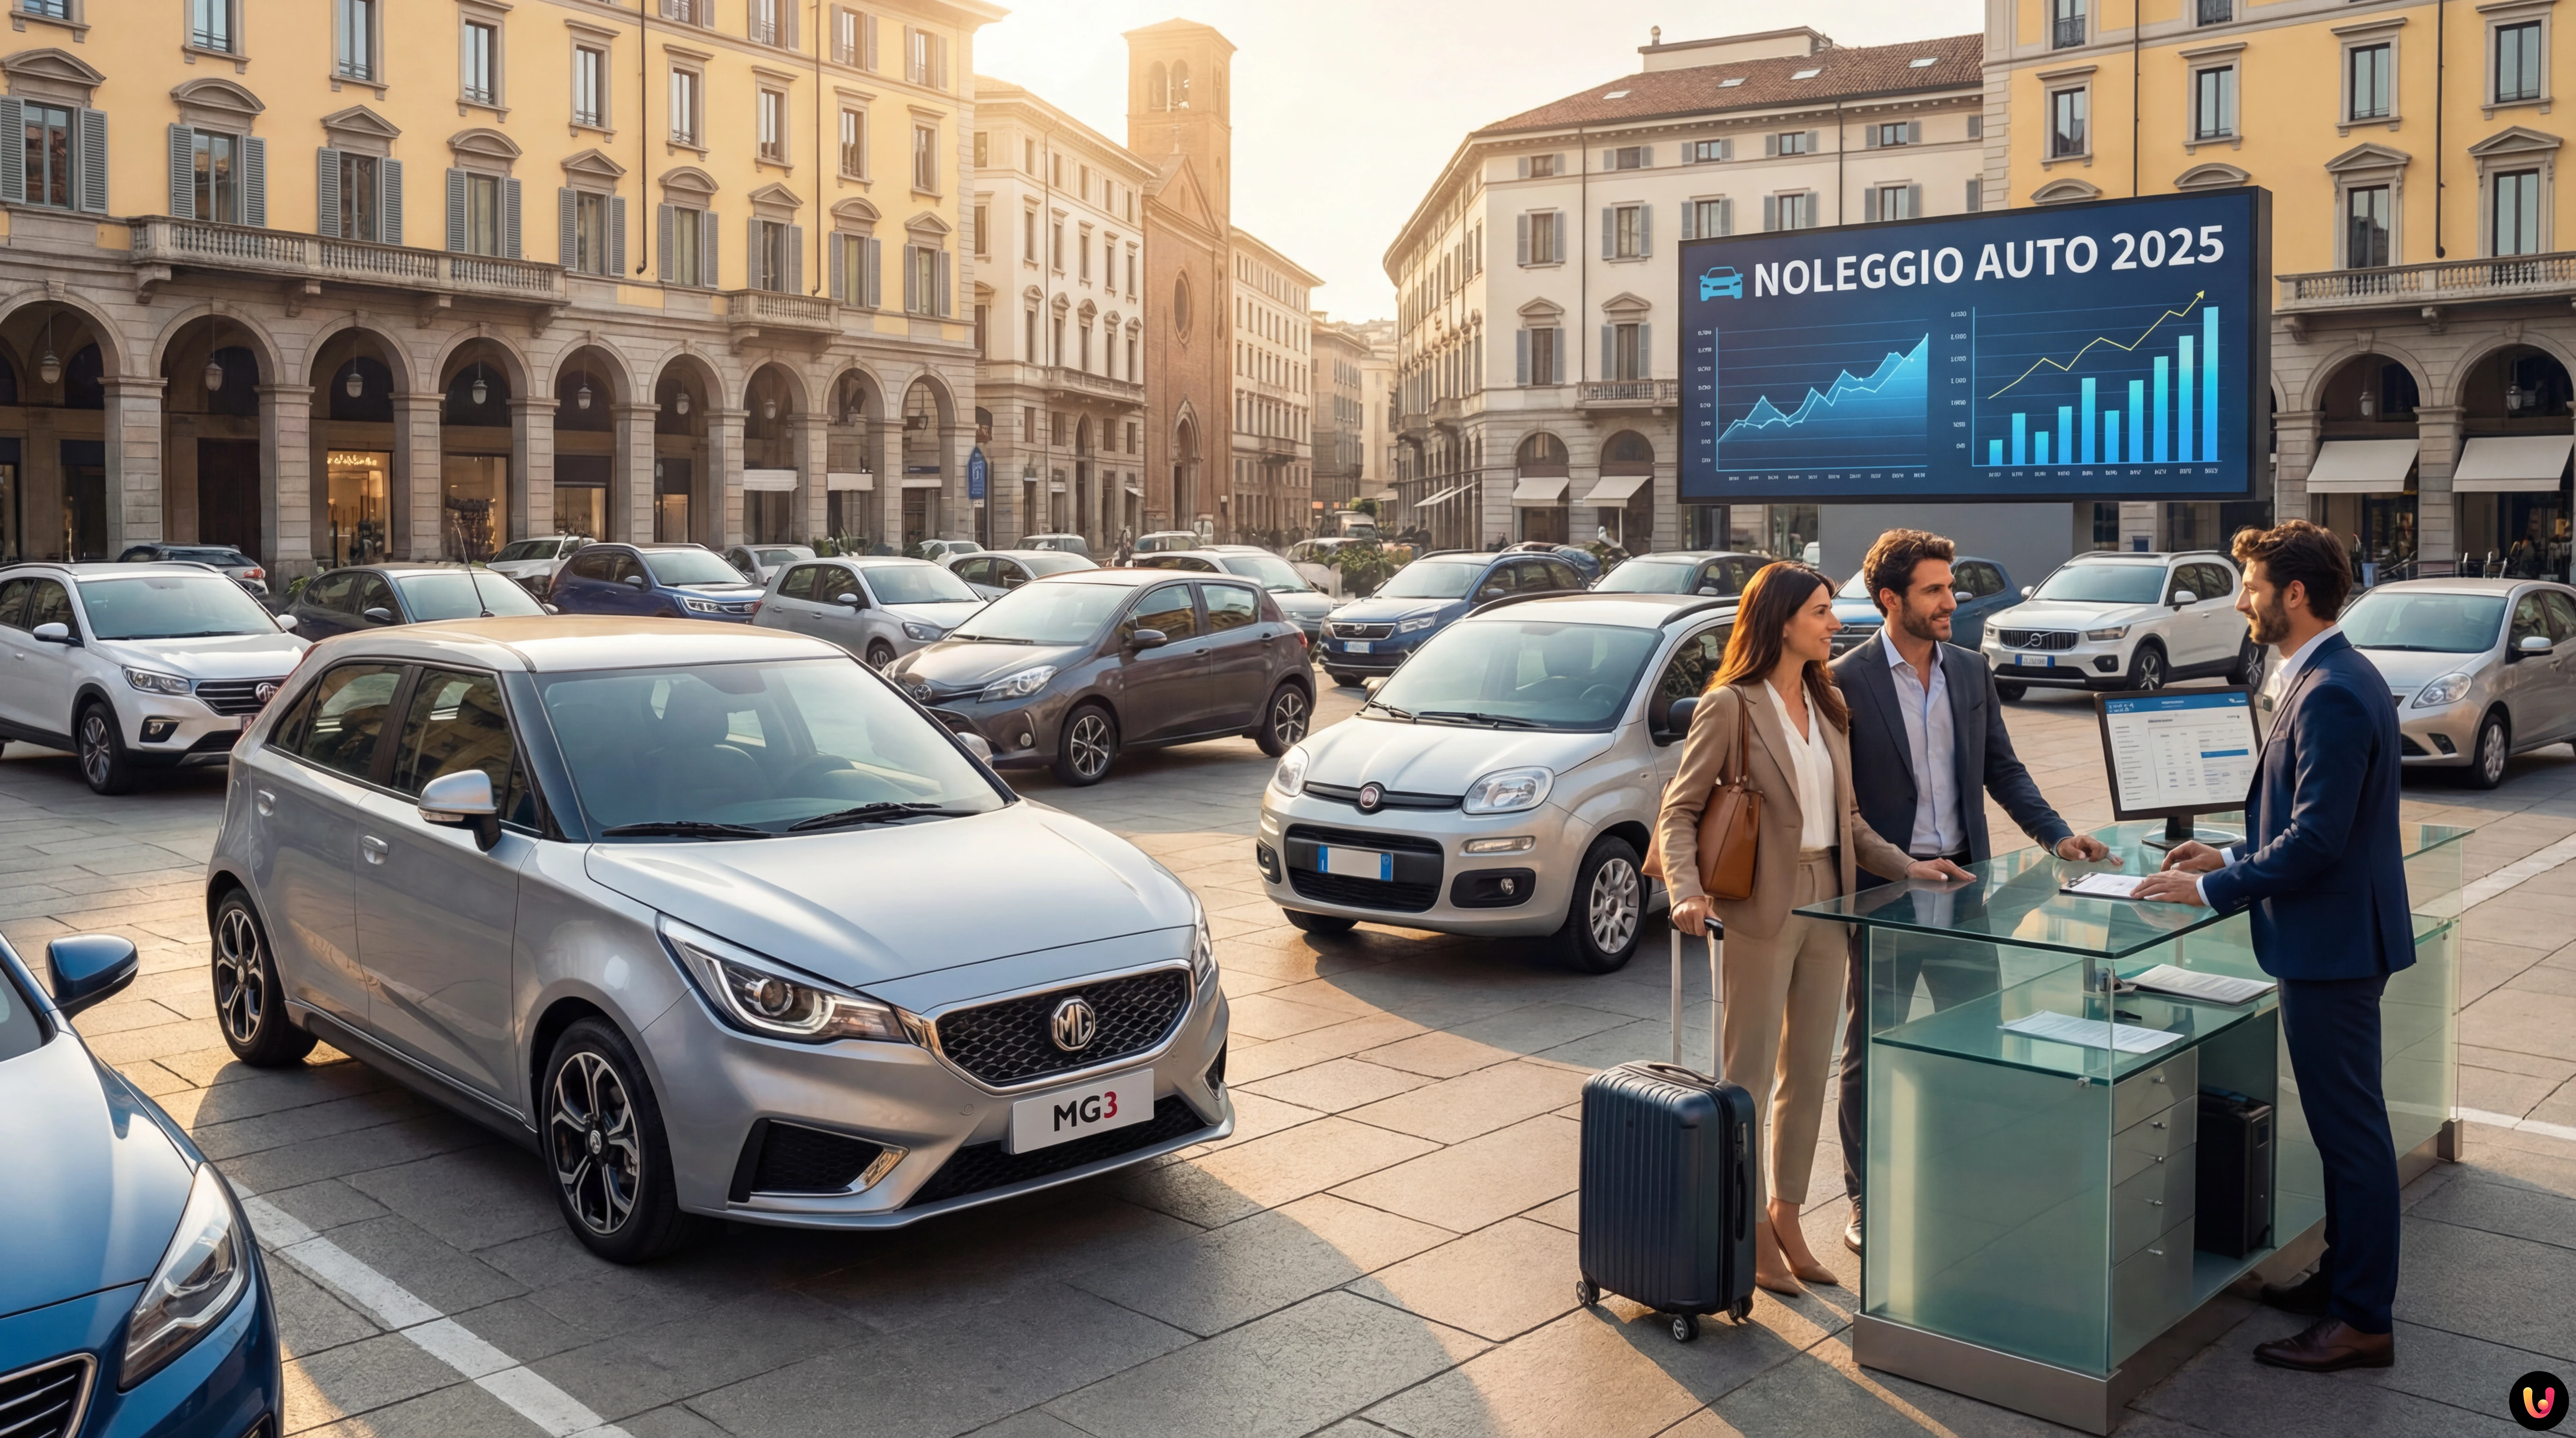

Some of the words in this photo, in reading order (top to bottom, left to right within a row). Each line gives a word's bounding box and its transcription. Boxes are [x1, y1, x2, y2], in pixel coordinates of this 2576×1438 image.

[1755, 247, 1963, 297] NOLEGGIO
[1974, 235, 2098, 281] AUTO
[2111, 225, 2224, 271] 2025
[1059, 1004, 1091, 1045] MG
[1054, 1091, 1118, 1132] MG3
